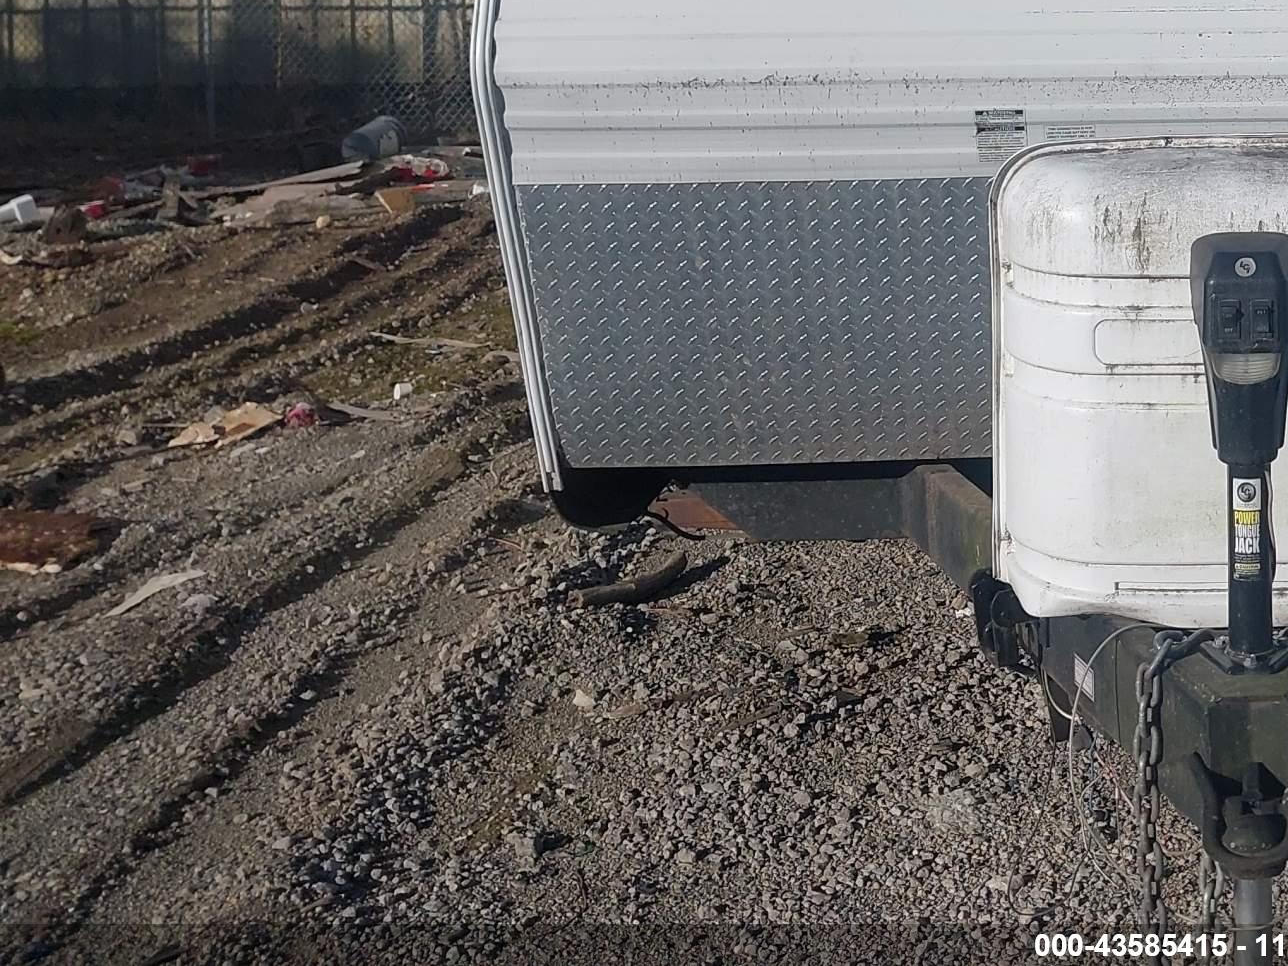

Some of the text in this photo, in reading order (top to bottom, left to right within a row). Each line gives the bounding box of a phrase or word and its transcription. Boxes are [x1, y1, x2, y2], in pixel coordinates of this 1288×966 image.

[1234, 511, 1260, 525] POWER
[1234, 524, 1260, 538] TONGUE
[1234, 537, 1260, 554] JACK
